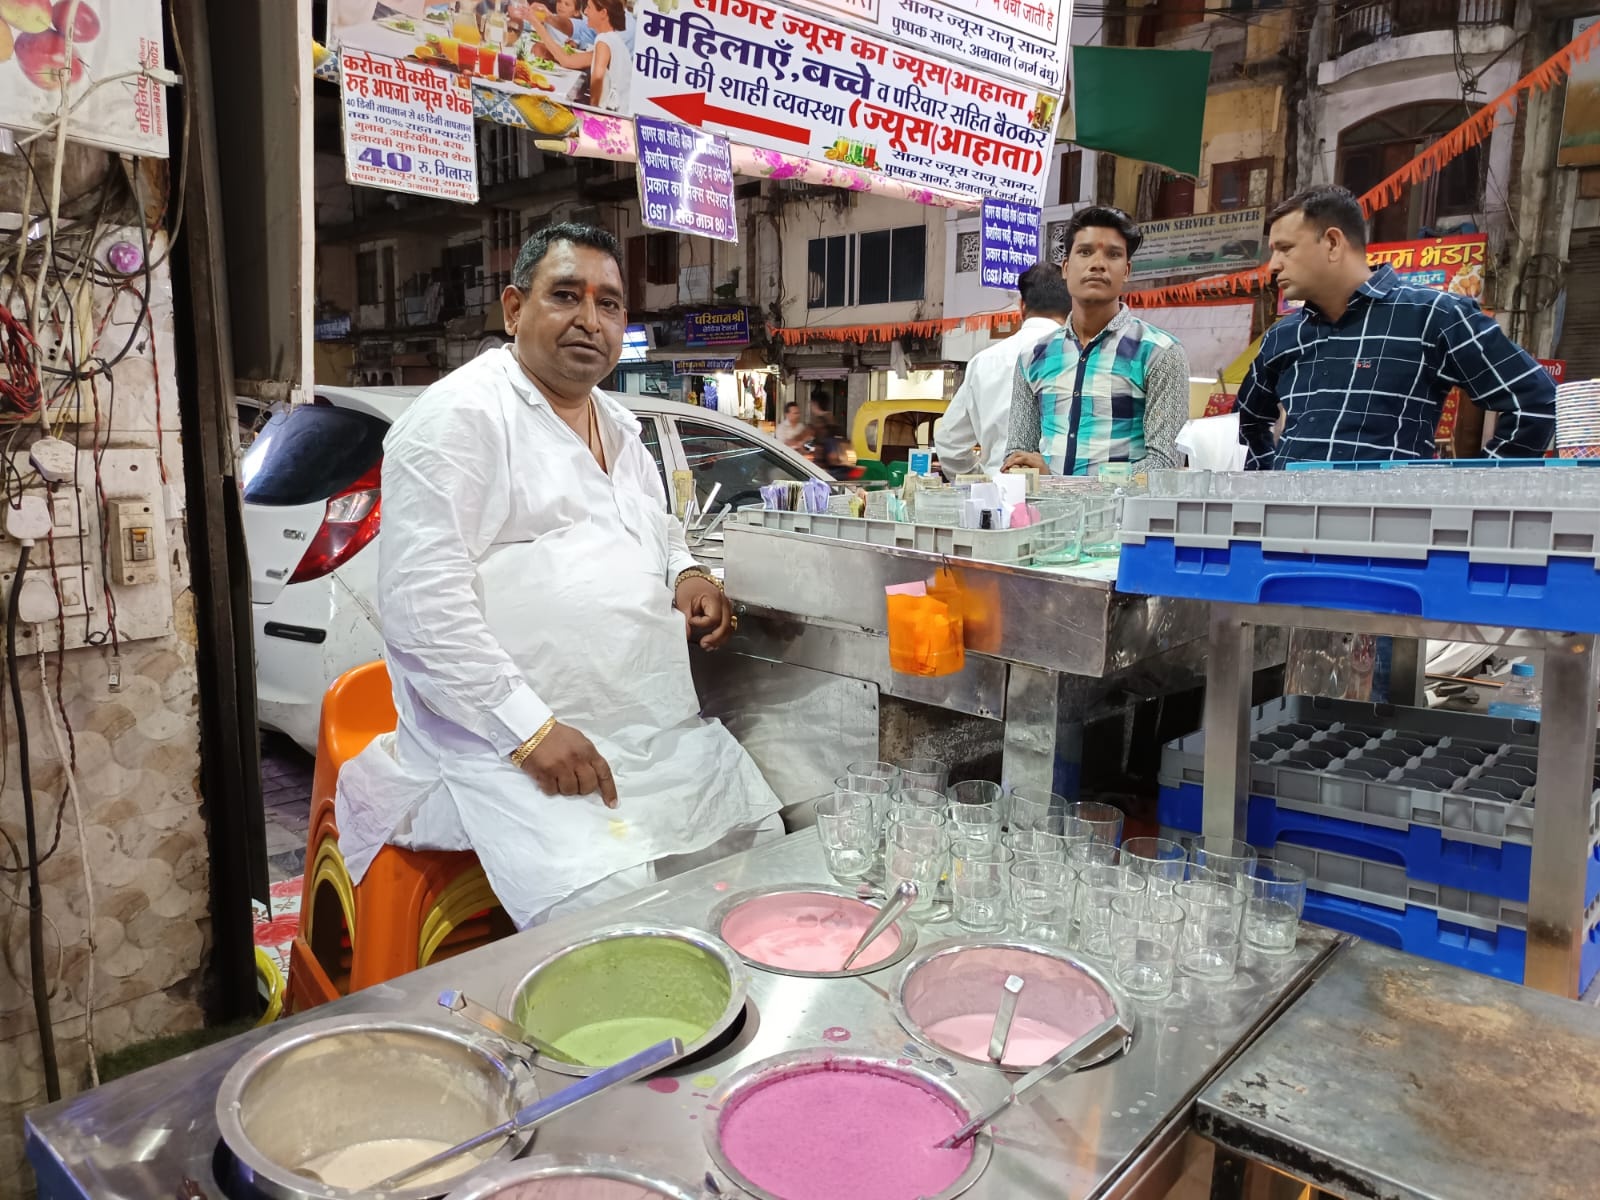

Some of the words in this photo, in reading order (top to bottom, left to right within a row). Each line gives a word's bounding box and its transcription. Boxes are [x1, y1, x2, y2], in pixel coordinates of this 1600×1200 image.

[782, 14, 845, 55] ज्यूस
[851, 36, 888, 65] का
[892, 16, 927, 36] पुष्पक
[969, 43, 1011, 68] अग्रवाल
[900, 0, 943, 22] सागर
[947, 13, 983, 39] ज्यूस
[987, 28, 1016, 53] राजू
[343, 51, 392, 79] करोना
[395, 57, 448, 92] वैक्सीन
[636, 46, 680, 84] पीने
[684, 62, 715, 93] की
[719, 76, 770, 106] शाही
[773, 89, 845, 126] व्यवस्था
[345, 73, 369, 98] रुह
[411, 86, 442, 113] ज्यूस
[446, 88, 473, 115] शेक
[346, 98, 356, 108] 40
[376, 103, 407, 118] तापमान
[408, 108, 416, 120] से
[444, 119, 472, 132] तापमान
[348, 110, 369, 120] तक
[375, 115, 404, 128] 100%
[405, 121, 432, 134] राहत
[877, 83, 888, 103] व
[893, 84, 948, 120] परिवार
[950, 102, 991, 133] सहित
[994, 111, 1047, 148] बैठकर
[641, 125, 657, 143] सागर
[657, 129, 666, 145] का
[358, 147, 412, 172] 40
[435, 159, 472, 183] गिलास
[884, 163, 917, 179] पुष्पक
[891, 150, 933, 168] सागर
[935, 162, 968, 178] ज्यूस
[972, 171, 997, 187] राजू
[646, 177, 669, 196] प्रकार
[705, 186, 729, 210] स्पेशल
[1139, 223, 1170, 235] CANON
[1174, 216, 1216, 232] SERVICE
[1219, 210, 1260, 225] CENTER
[1420, 238, 1486, 268] भंडार
